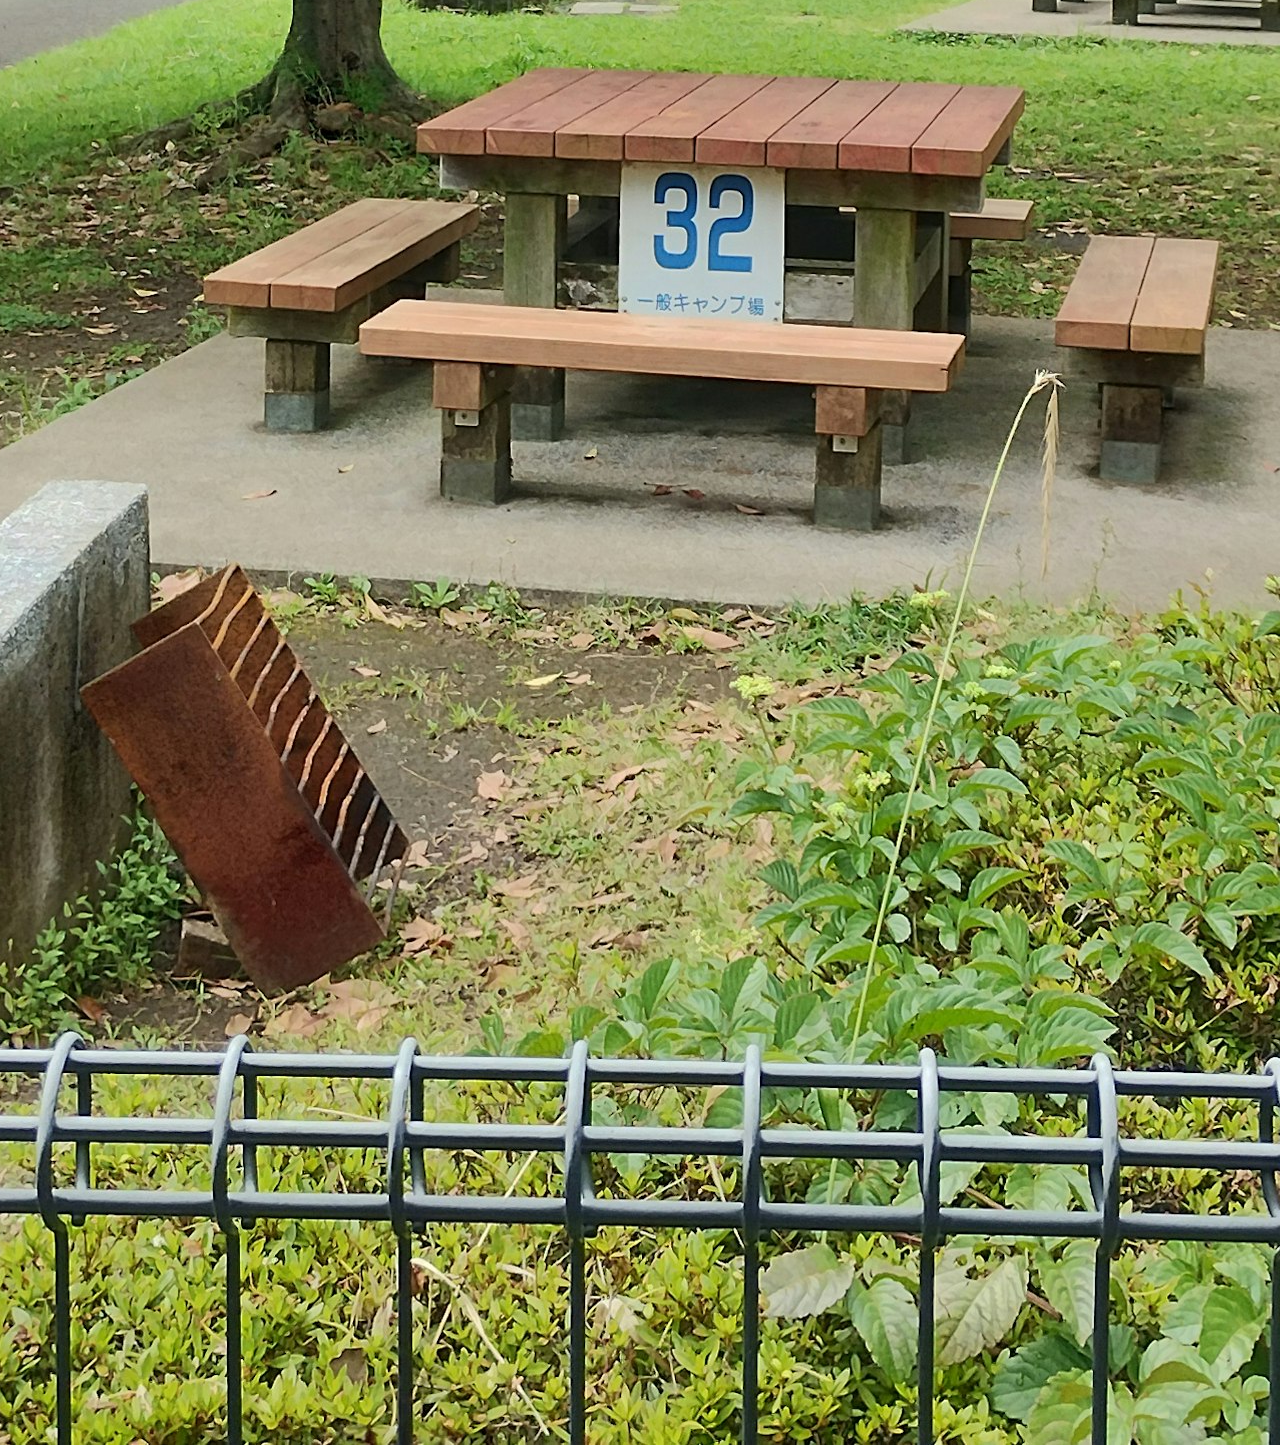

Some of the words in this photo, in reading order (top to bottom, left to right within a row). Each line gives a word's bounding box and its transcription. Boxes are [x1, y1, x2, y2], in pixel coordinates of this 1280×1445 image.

[653, 172, 754, 273] 32
[638, 293, 764, 316] 一般キャンプ場
